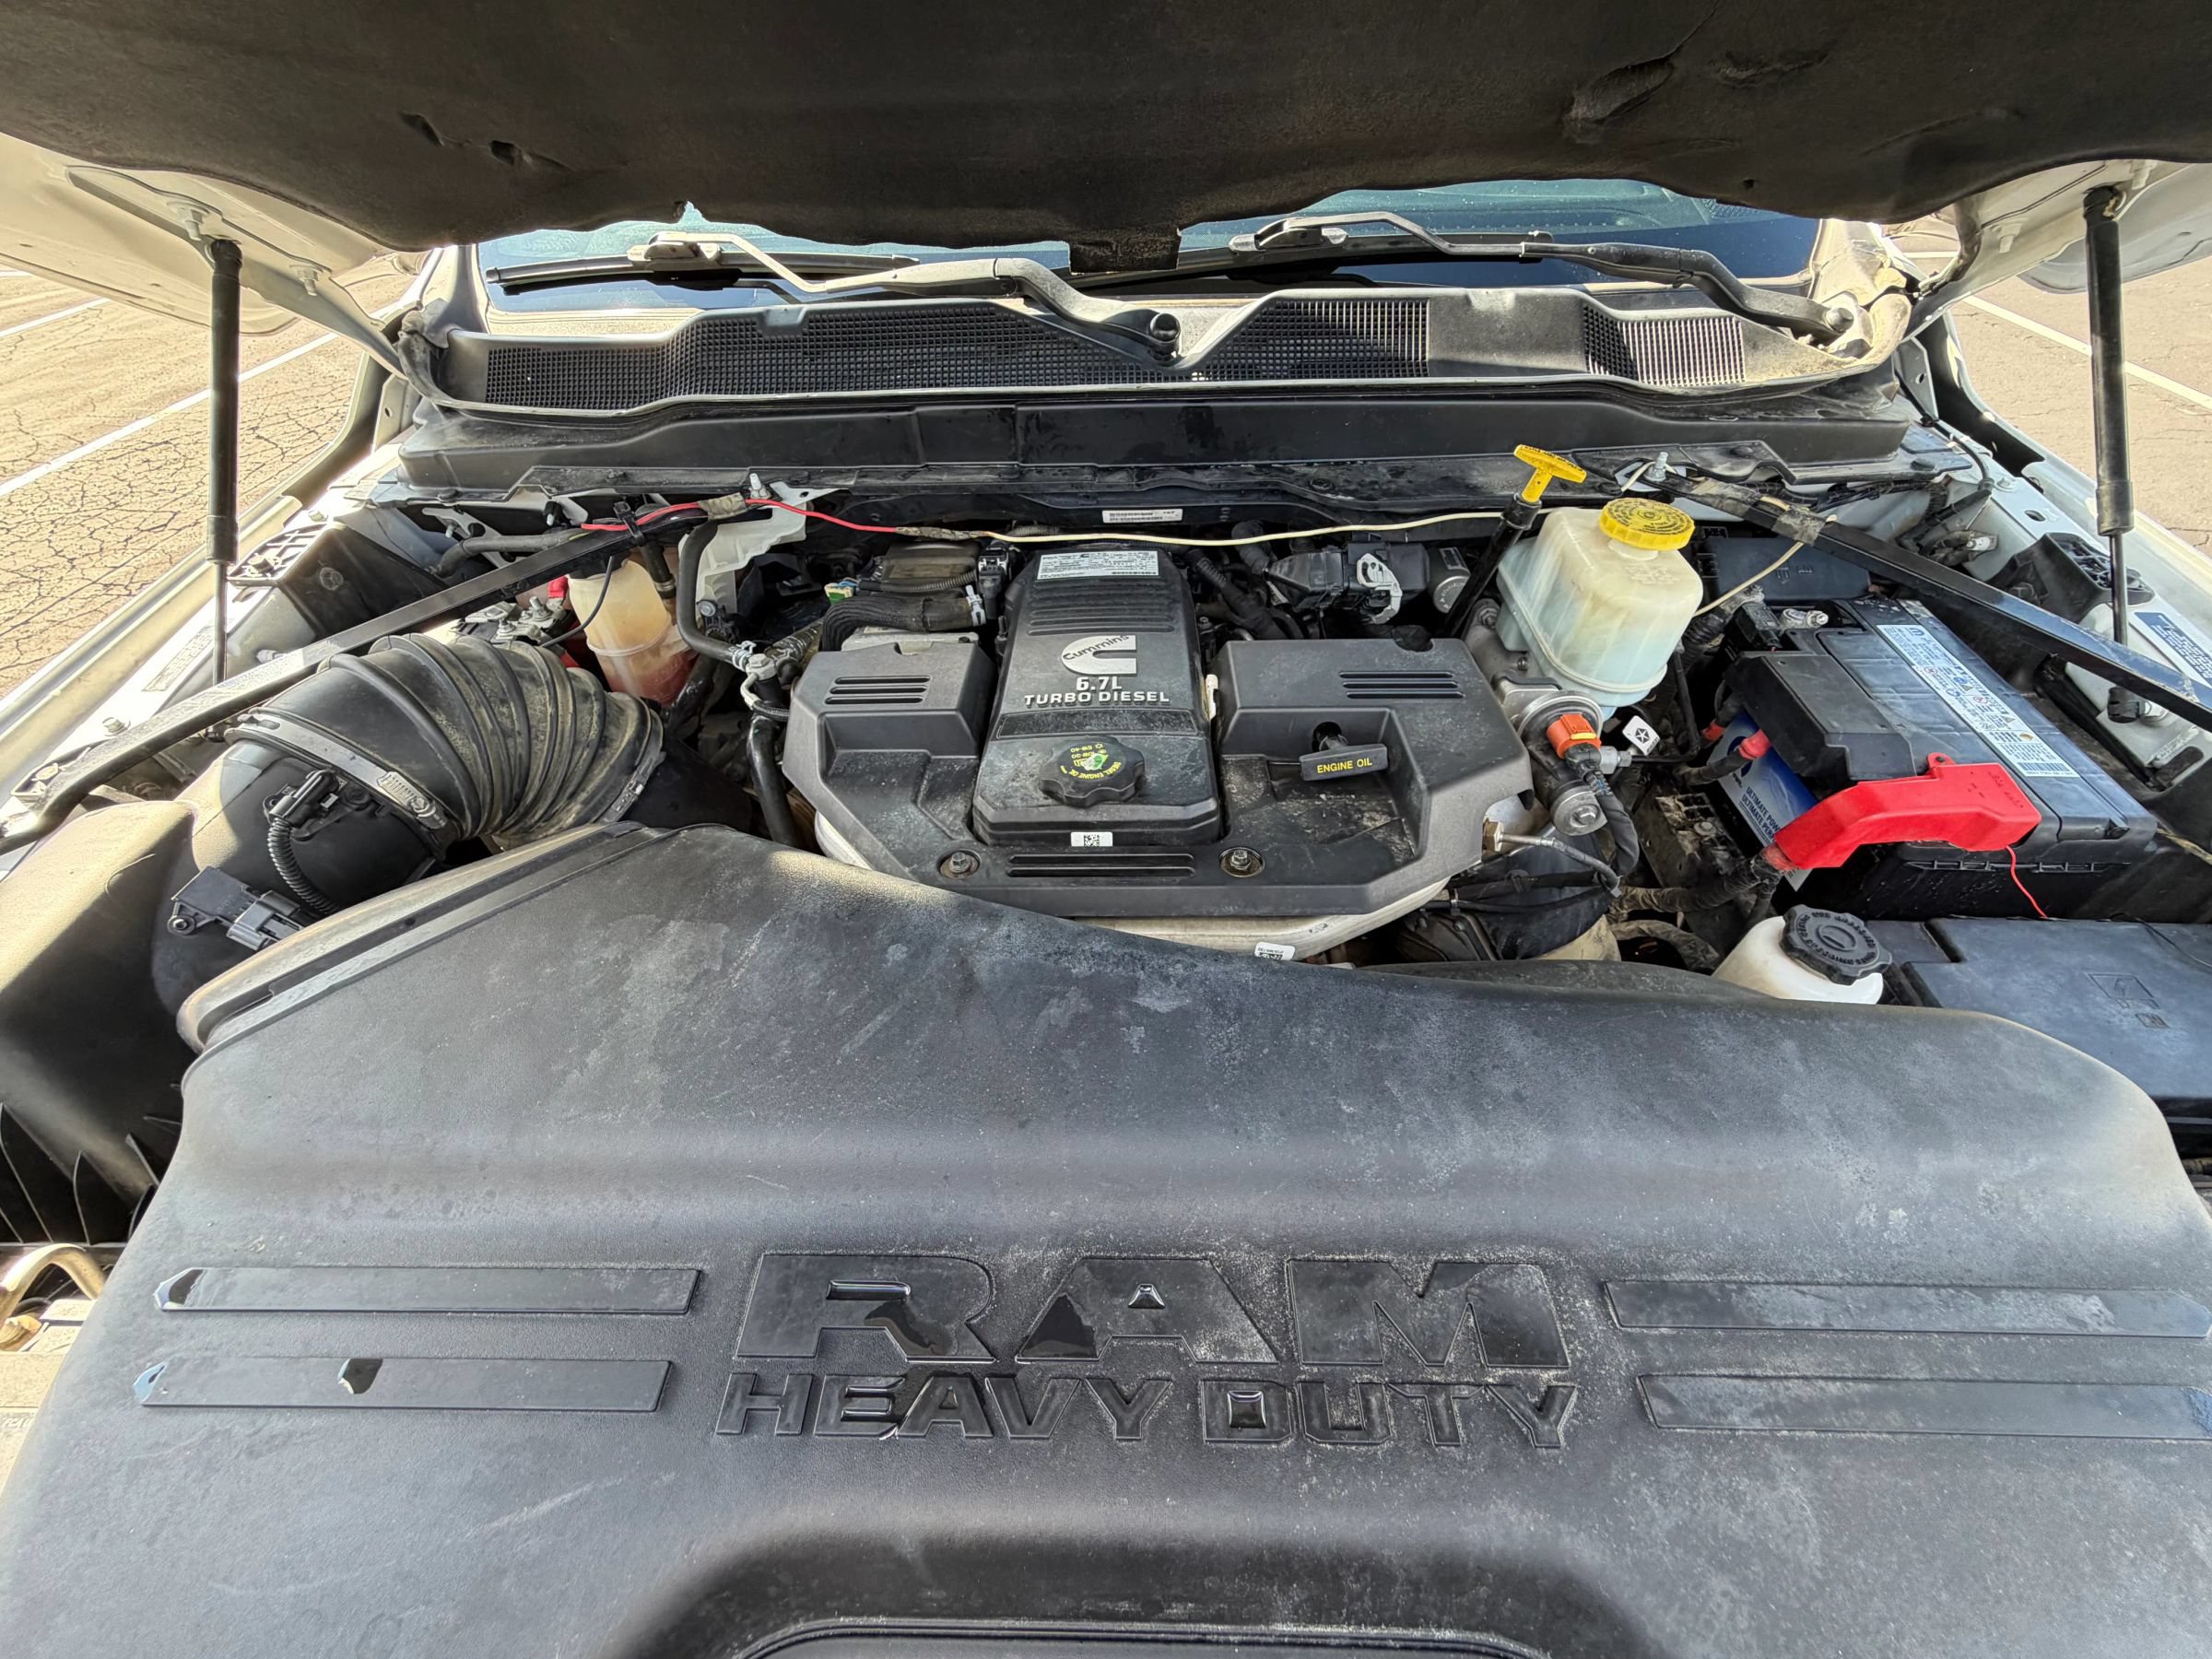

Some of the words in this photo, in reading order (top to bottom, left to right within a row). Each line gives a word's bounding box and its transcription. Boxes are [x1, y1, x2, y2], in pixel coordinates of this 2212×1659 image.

[1062, 635, 1131, 660] Cummins
[1076, 676, 1123, 692] 6.7L
[1024, 691, 1092, 707] TURBO
[1099, 690, 1171, 704] DIESEL
[1317, 759, 1354, 773] ENGINE
[1356, 757, 1373, 768] OIL
[1741, 794, 1764, 826] ULTIMATE
[1746, 785, 1770, 818] ULTIMATE
[1766, 814, 1781, 832] POW
[735, 1253, 1571, 1368] RAM
[714, 1371, 1173, 1440] HEAVY
[1201, 1379, 1578, 1448] DUTY
